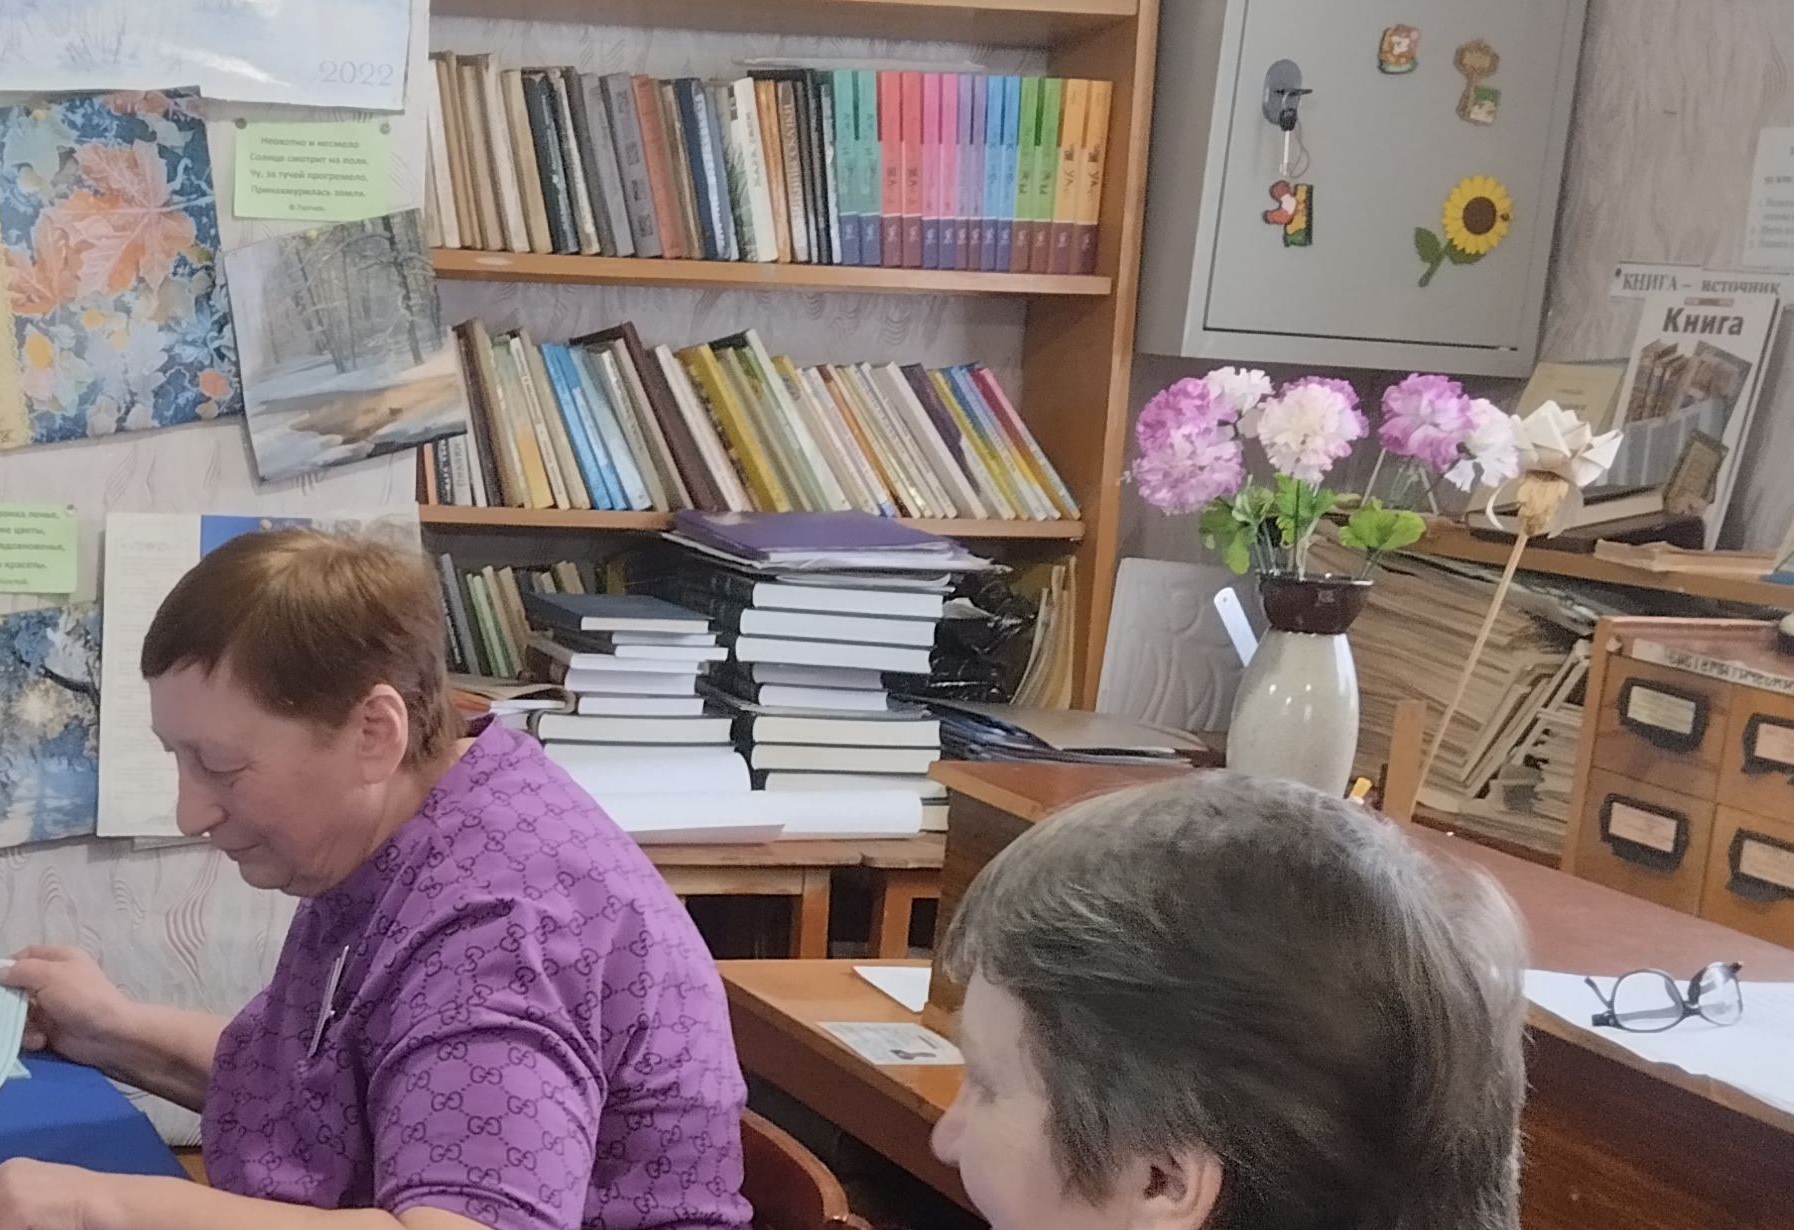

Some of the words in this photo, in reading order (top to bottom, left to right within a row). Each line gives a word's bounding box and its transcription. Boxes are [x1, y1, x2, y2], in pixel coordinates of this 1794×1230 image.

[318, 60, 394, 86] 2022
[249, 152, 285, 163] Солнце
[287, 155, 326, 165] смотрит
[278, 170, 305, 180] тучей
[1622, 272, 1678, 291] КНИГА
[1662, 306, 1745, 336] Книга
